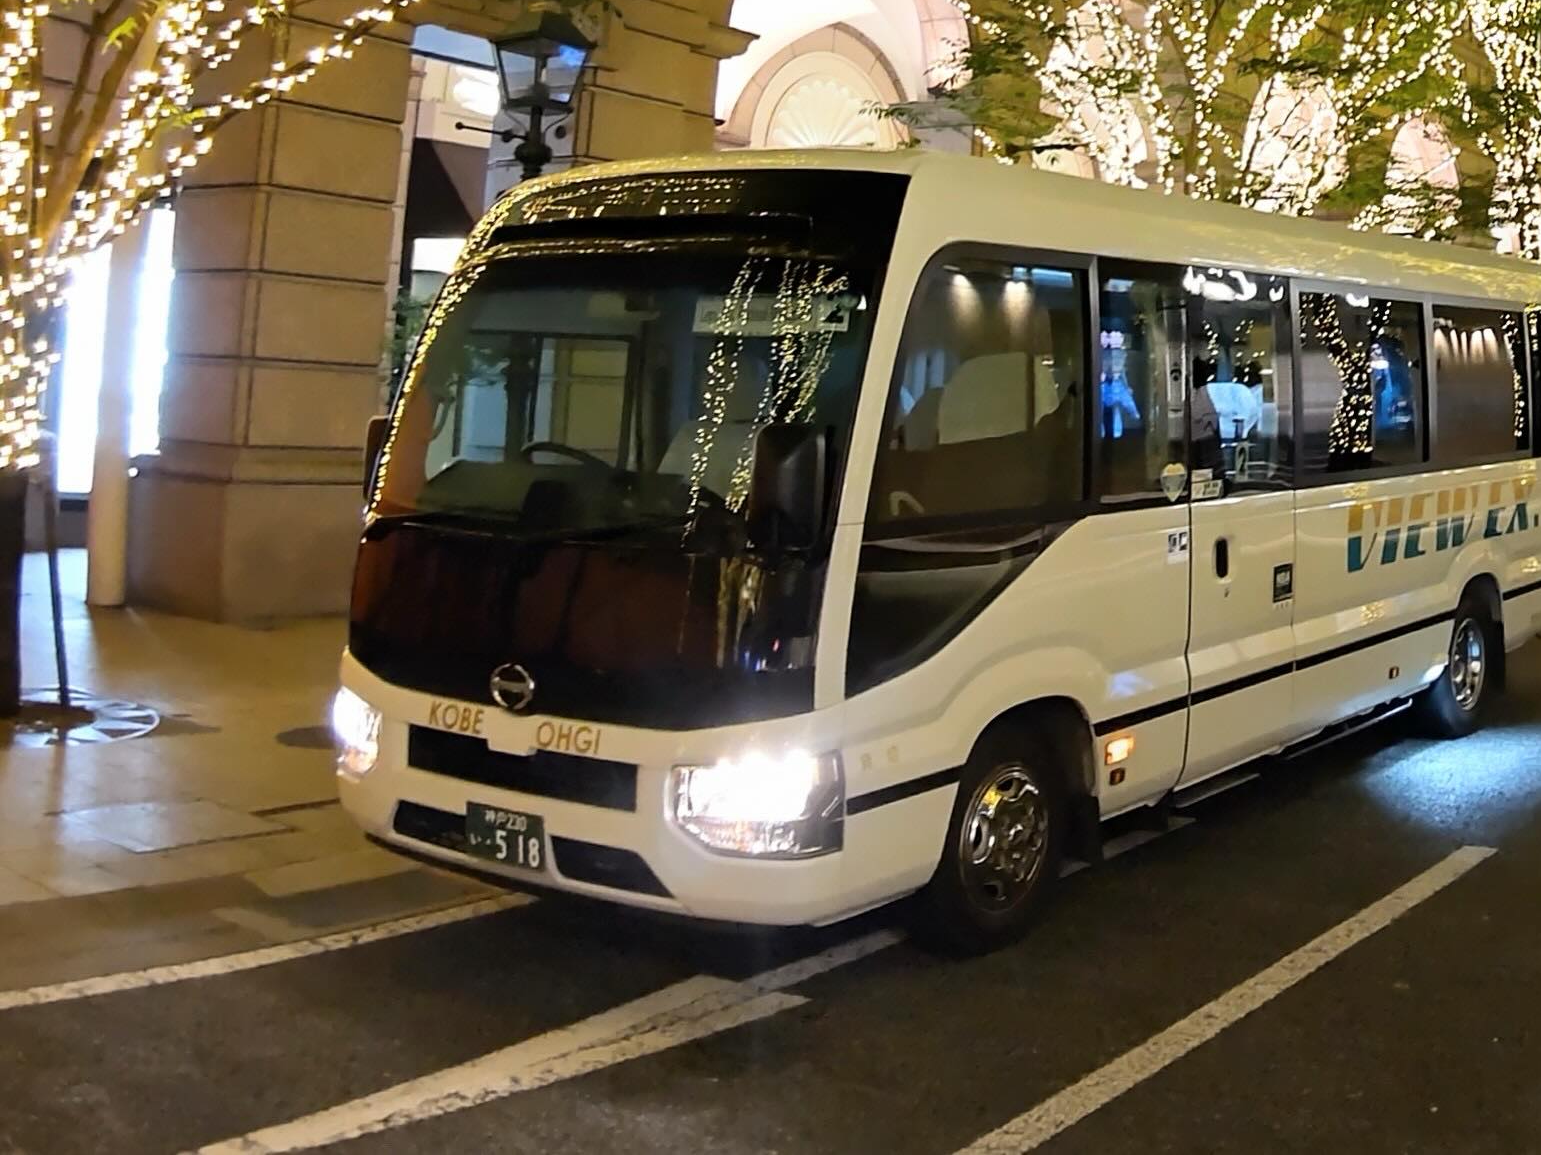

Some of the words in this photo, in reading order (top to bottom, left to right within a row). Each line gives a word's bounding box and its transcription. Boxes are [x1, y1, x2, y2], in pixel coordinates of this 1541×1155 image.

[1347, 485, 1479, 573] VIEW
[429, 701, 485, 734] KOBE
[536, 721, 602, 755] OHGI
